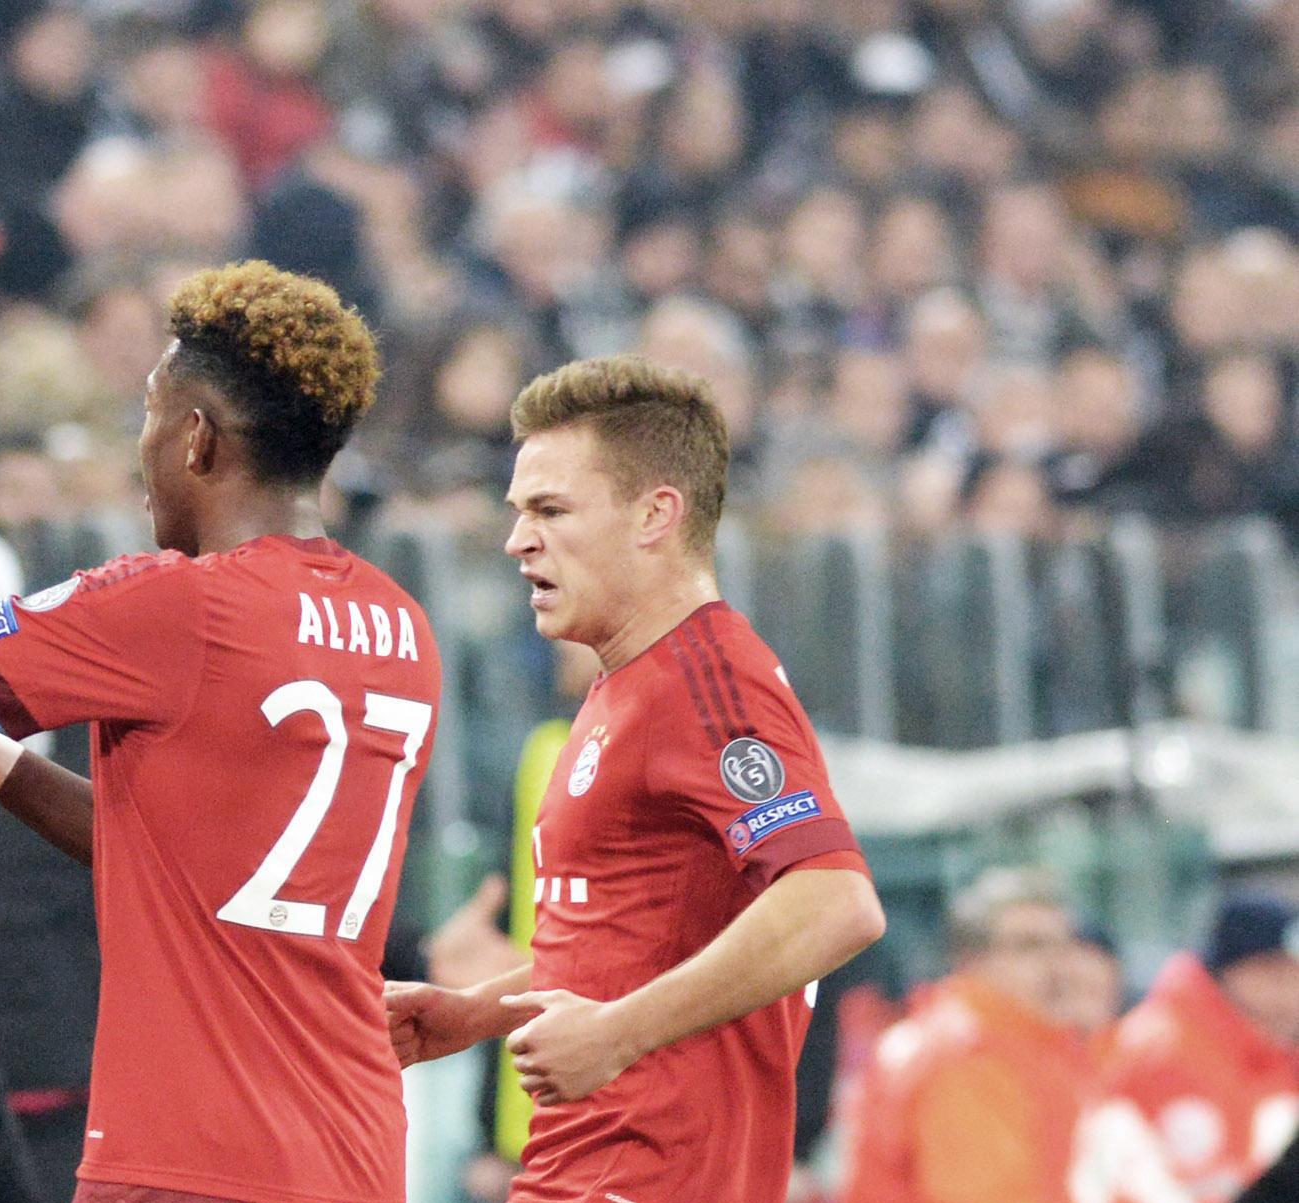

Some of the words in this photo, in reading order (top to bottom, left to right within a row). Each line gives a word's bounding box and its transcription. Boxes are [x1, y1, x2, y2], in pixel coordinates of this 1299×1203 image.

[298, 592, 418, 661] ALABA
[747, 766, 766, 786] 5
[216, 679, 432, 940] 27
[747, 796, 816, 833] RESPECT
